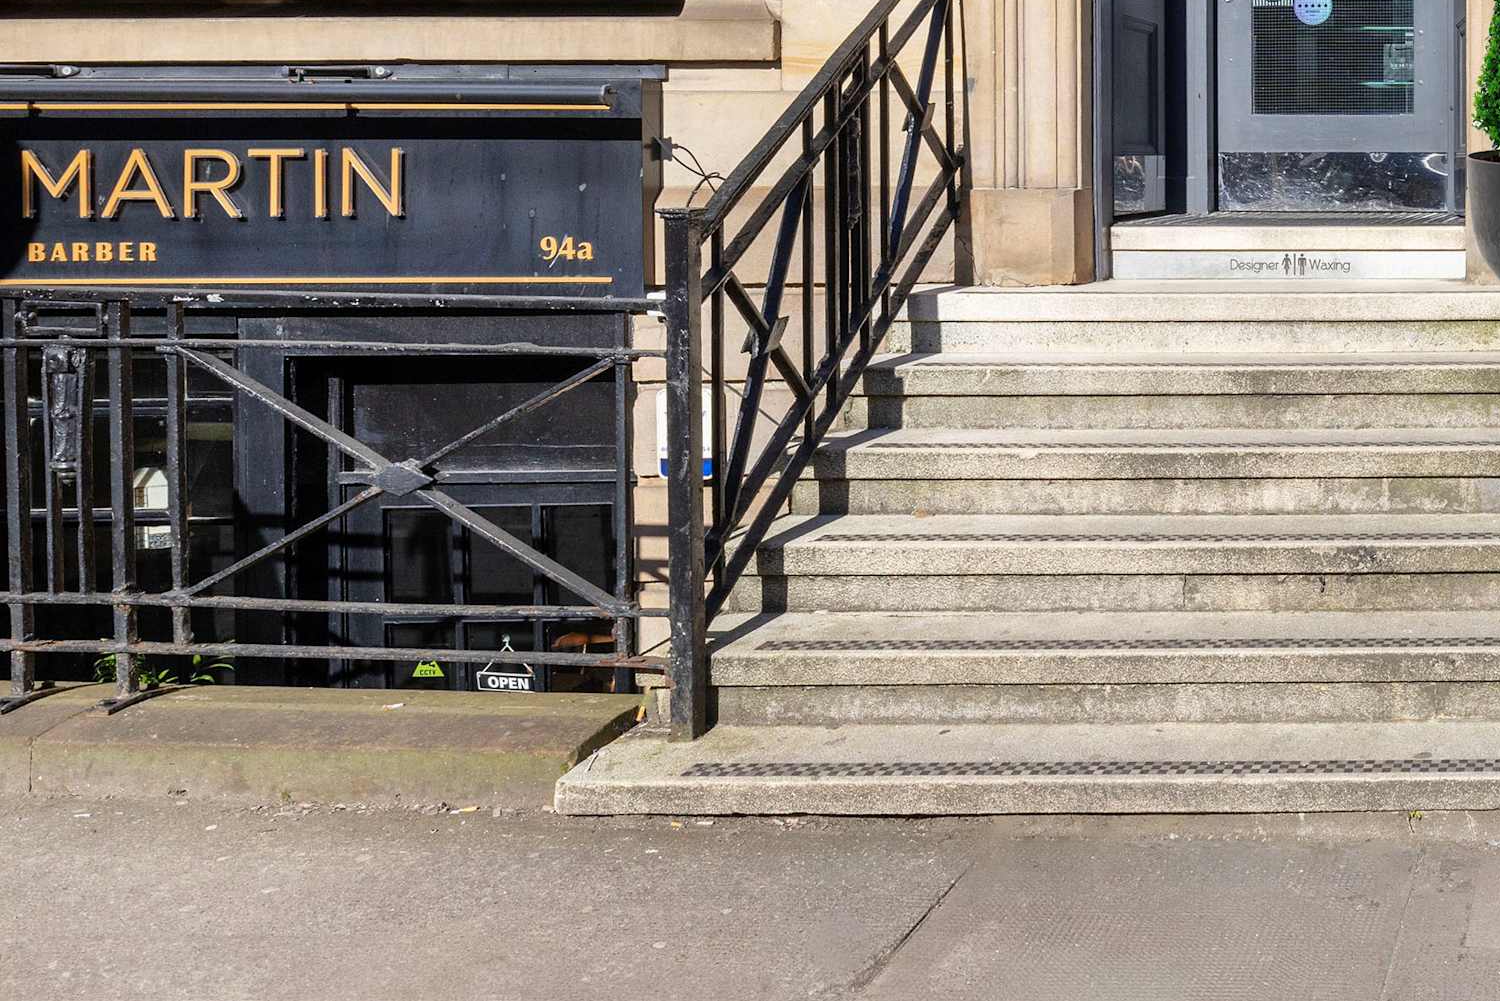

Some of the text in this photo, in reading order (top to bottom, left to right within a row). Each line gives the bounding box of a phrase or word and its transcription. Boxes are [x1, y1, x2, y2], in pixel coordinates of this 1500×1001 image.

[21, 147, 403, 219] MARTIN
[28, 242, 158, 262] BARBER
[540, 235, 594, 260] 94a
[1230, 258, 1351, 273] Designer Waxing
[419, 668, 437, 676] CCTV
[487, 675, 530, 690] OPEN
